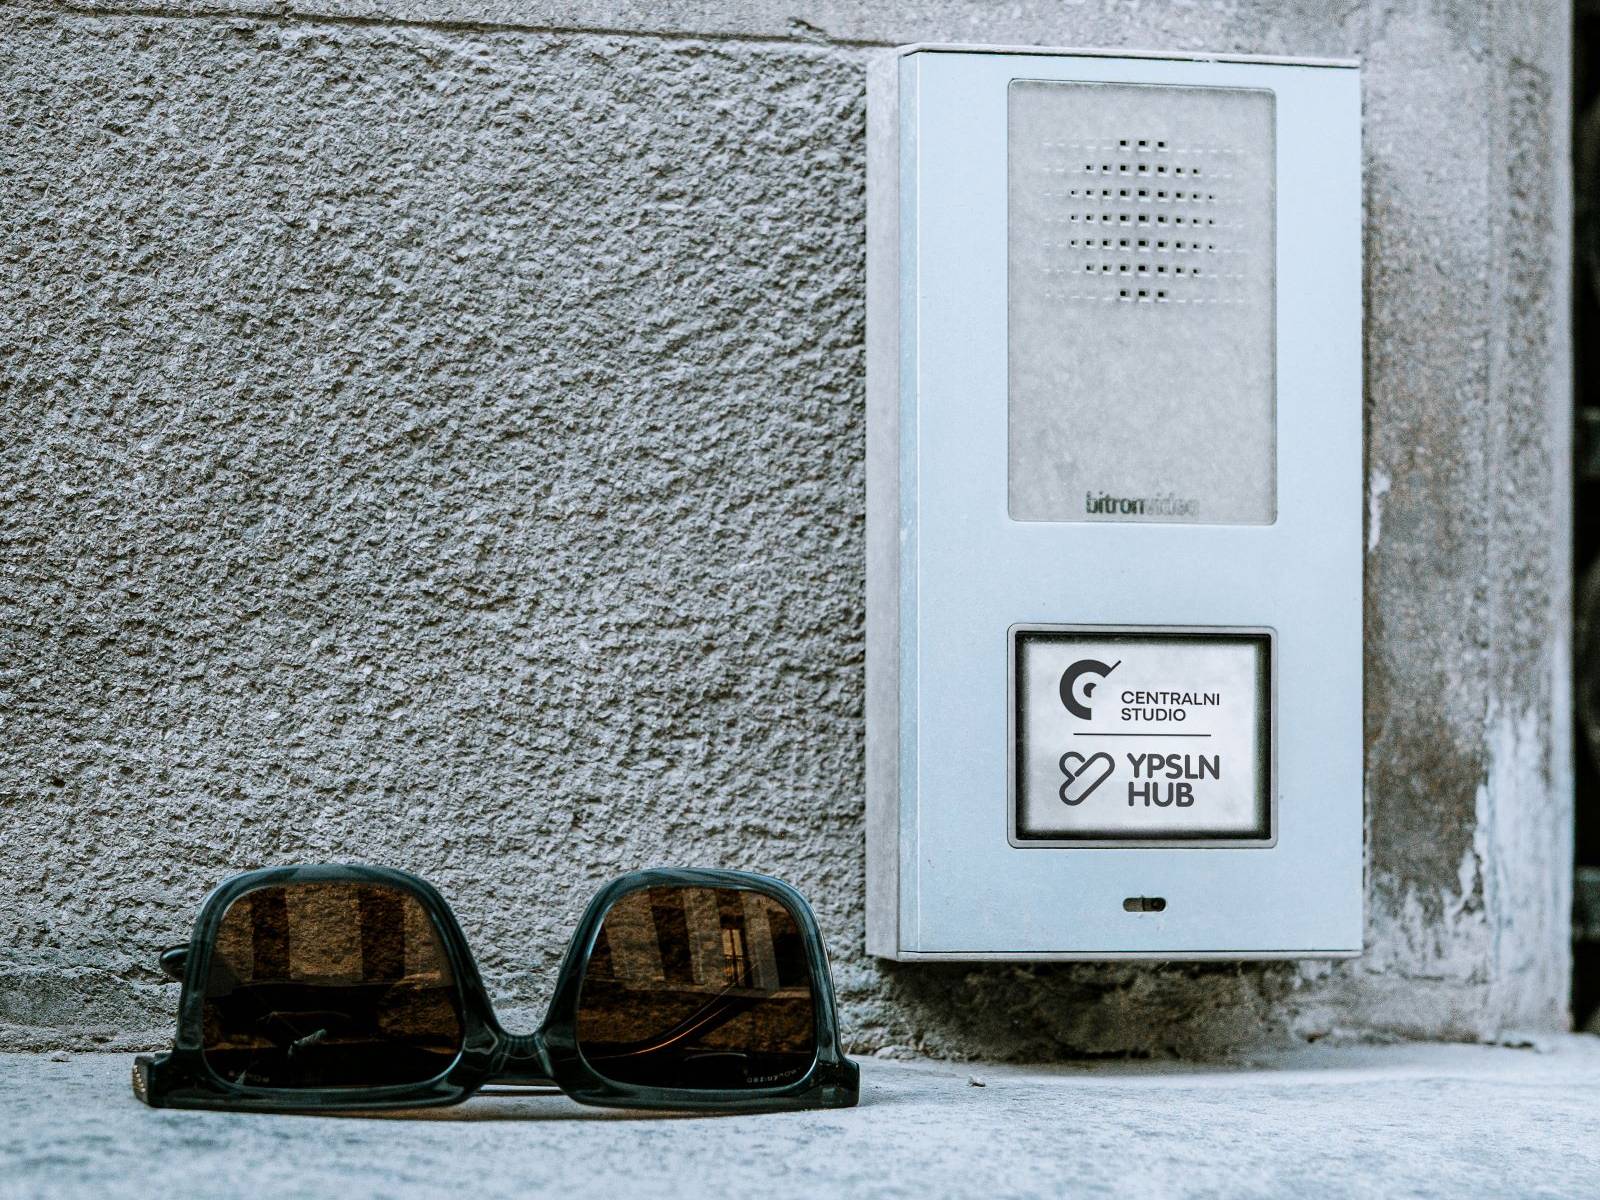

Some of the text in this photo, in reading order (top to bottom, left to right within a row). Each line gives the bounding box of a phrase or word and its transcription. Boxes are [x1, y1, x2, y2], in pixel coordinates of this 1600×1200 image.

[1121, 690, 1220, 706] CENTRALNI
[1121, 708, 1186, 722] STUDIO
[1126, 752, 1220, 780] YPSLN
[1128, 781, 1195, 808] HUB
